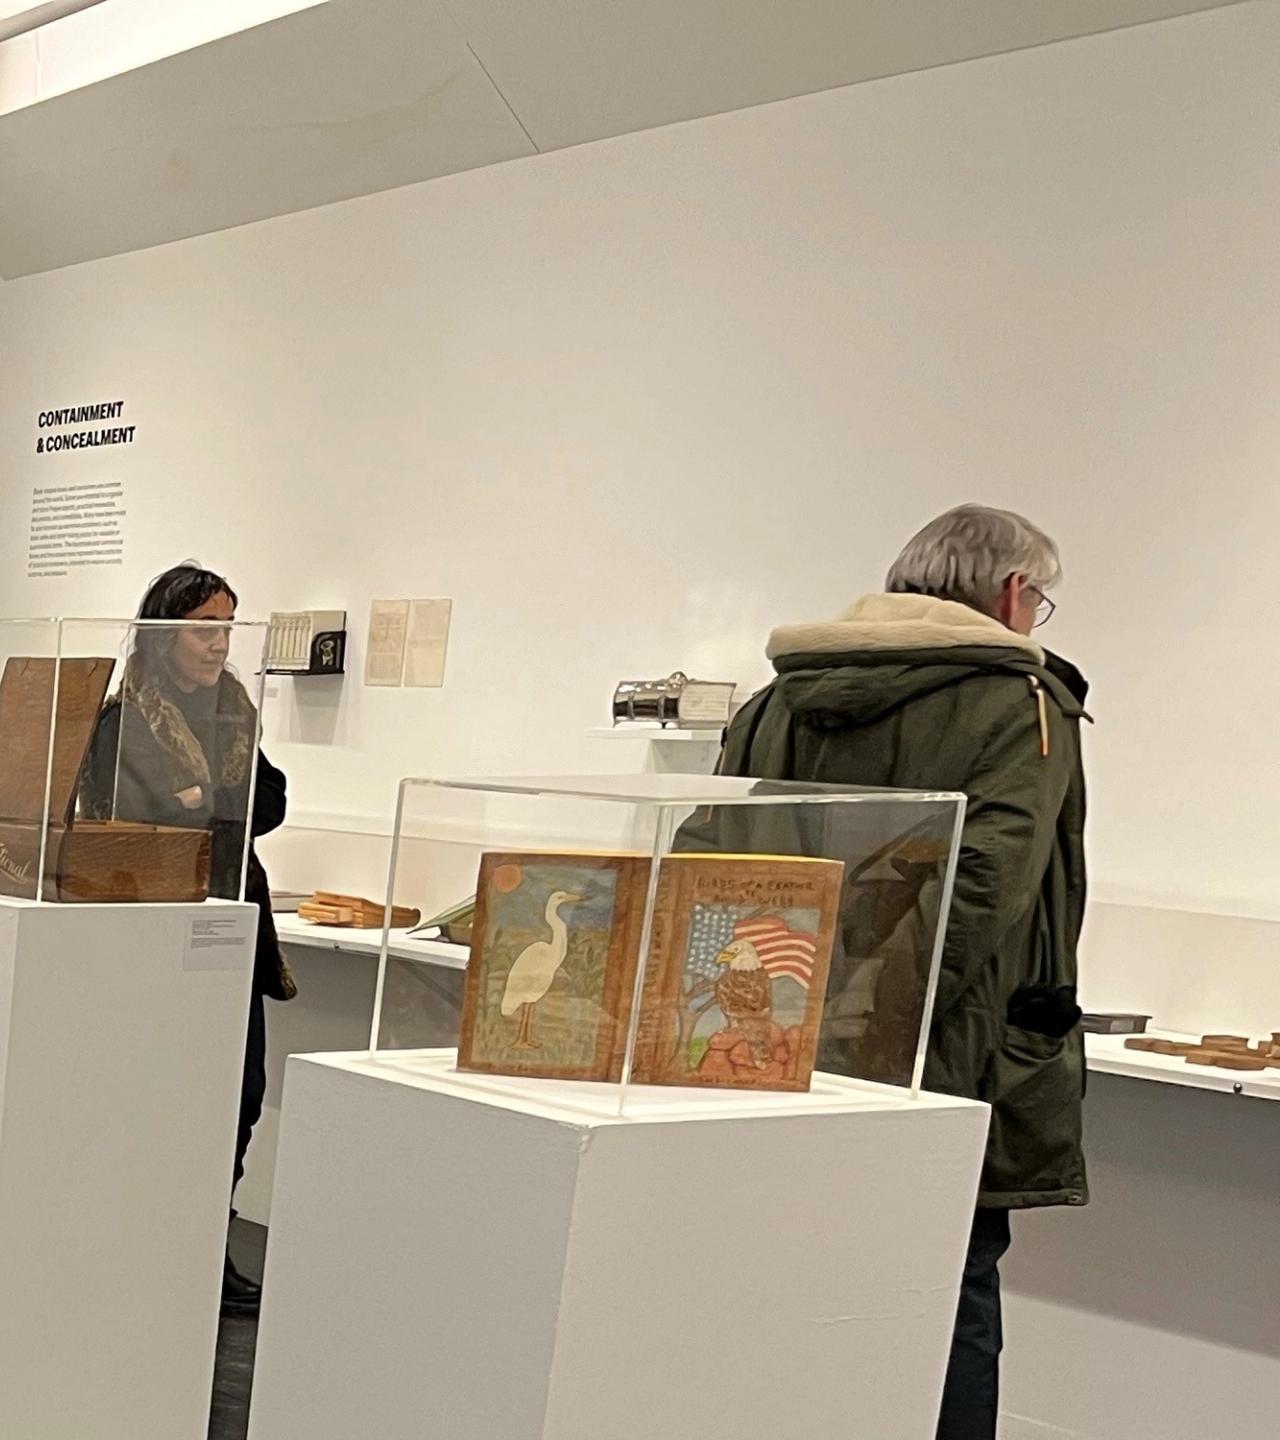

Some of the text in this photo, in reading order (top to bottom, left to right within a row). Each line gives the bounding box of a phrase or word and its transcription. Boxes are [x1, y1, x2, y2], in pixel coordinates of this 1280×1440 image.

[38, 401, 124, 428] CONTAINMENT
[36, 426, 136, 454] & CONCEALMENT
